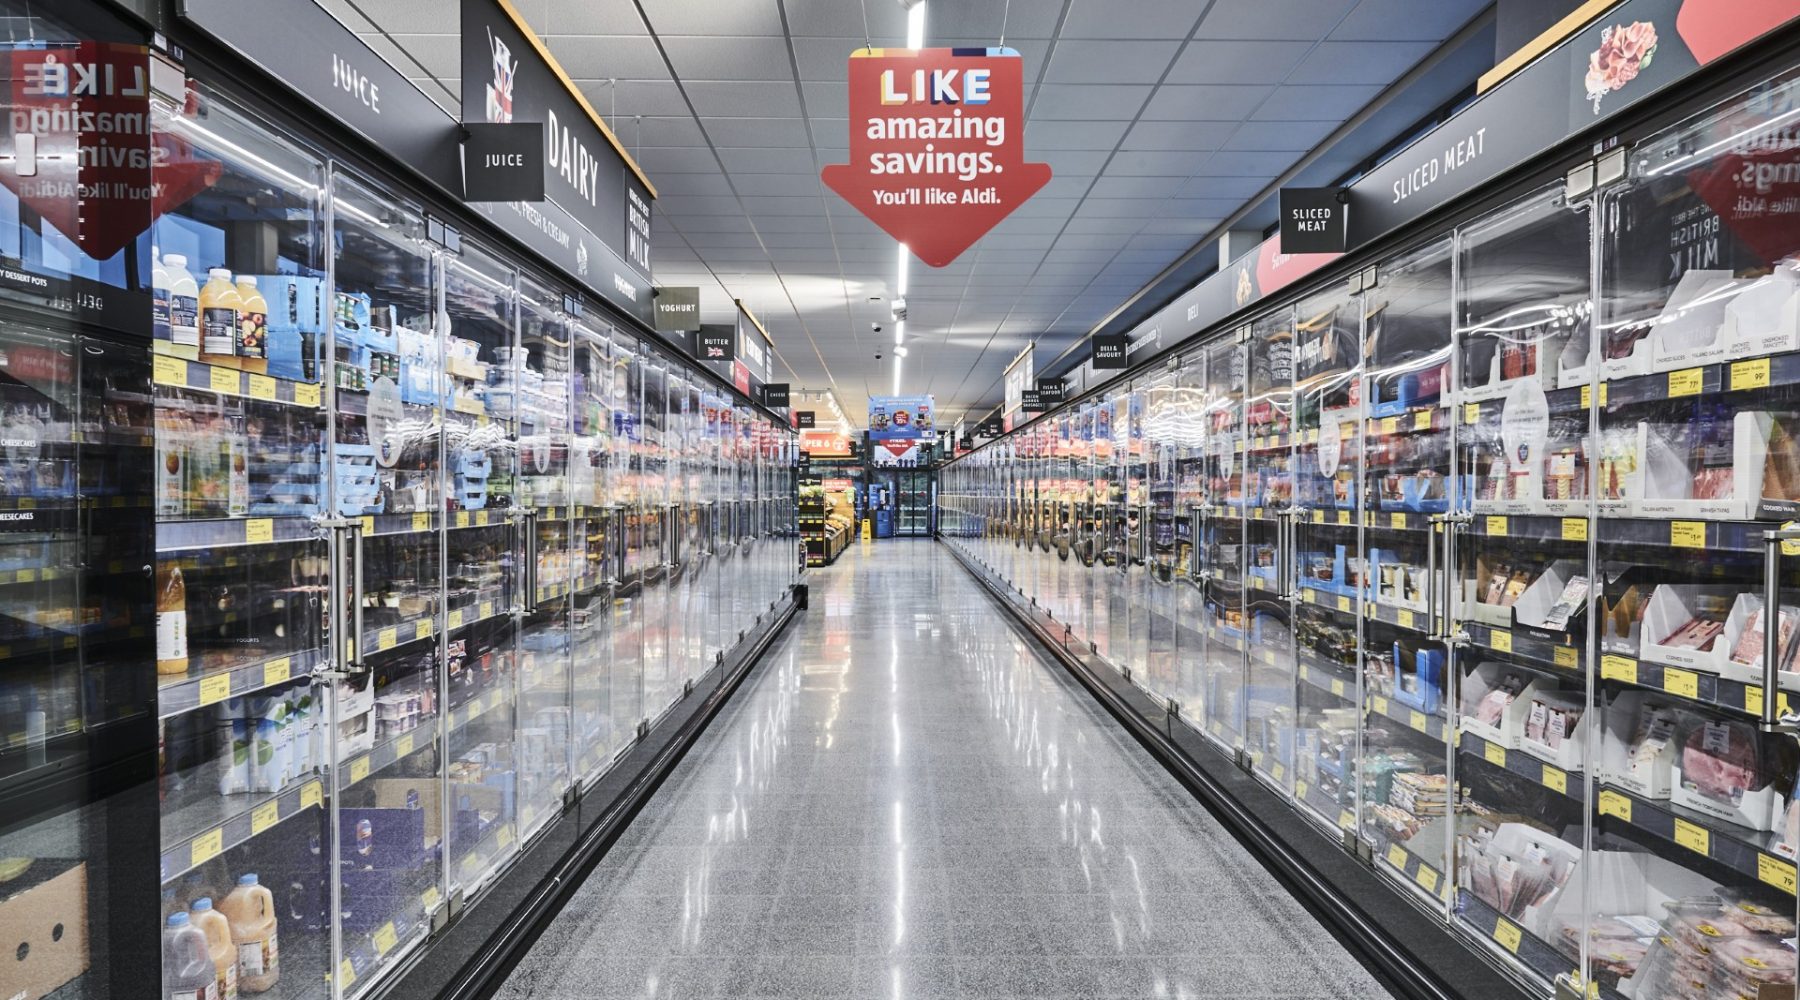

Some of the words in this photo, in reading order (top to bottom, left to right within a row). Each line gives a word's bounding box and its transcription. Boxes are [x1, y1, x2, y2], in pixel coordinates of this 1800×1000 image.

[332, 53, 381, 114] JUICE
[881, 69, 991, 105] LIKE
[867, 109, 1005, 146] amazing
[486, 154, 523, 167] JUICE
[548, 109, 599, 207] DAIRY
[870, 144, 1003, 181] savings.
[1393, 158, 1439, 204] SLICED
[1444, 127, 1486, 174] MEAT
[873, 188, 921, 205] You'll
[925, 188, 957, 205] like
[961, 188, 1001, 205] Aldi.
[629, 203, 650, 239] BRITISH
[1293, 208, 1331, 220] SLICED
[1298, 220, 1327, 232] MEAT
[629, 227, 650, 272] MILK
[5, 271, 31, 283] DESSERT
[31, 276, 48, 287] POTS
[660, 304, 695, 312] YOGHURT
[1187, 303, 1199, 321] DELI
[704, 338, 729, 346] BUTTER
[1, 439, 36, 448] CHEESECAKES
[823, 439, 830, 447] 6
